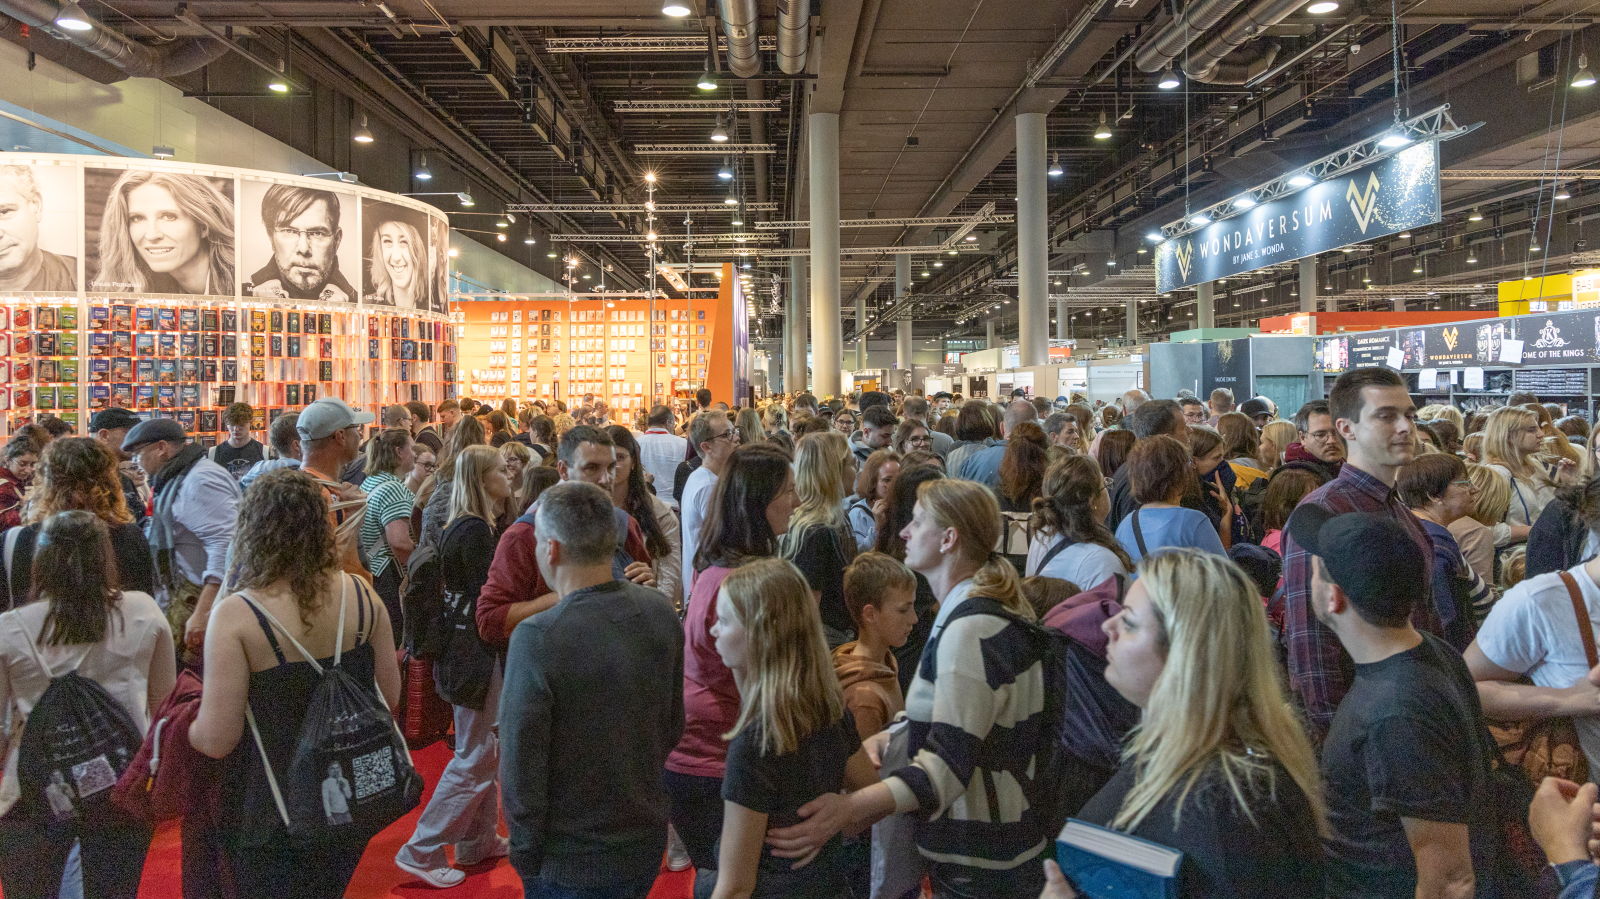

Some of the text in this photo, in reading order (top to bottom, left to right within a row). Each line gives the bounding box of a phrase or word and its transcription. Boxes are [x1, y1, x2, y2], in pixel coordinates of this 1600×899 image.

[1200, 199, 1333, 259] WONDAVERSUM
[1233, 242, 1285, 265] BY JANE S. WONDA
[1429, 353, 1473, 361] WONDAVERSUM
[1522, 348, 1585, 359] OME OF THE KINGS
